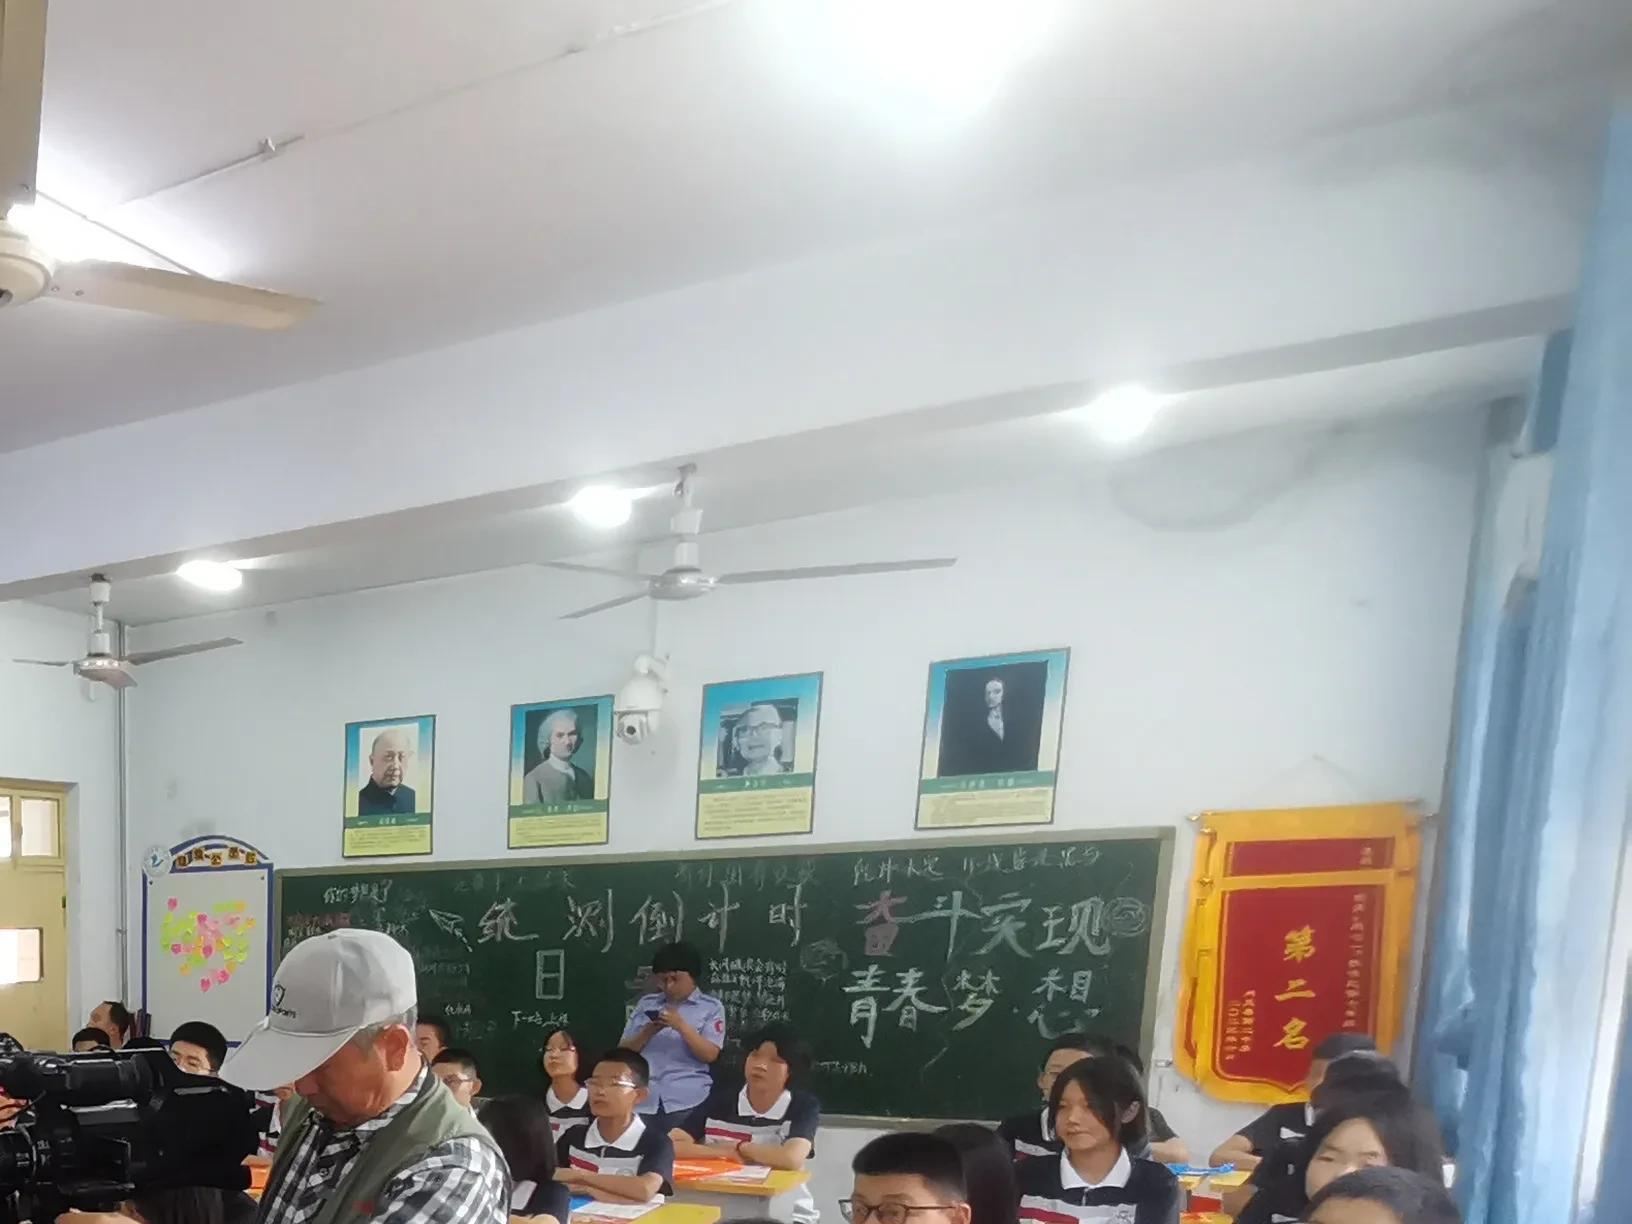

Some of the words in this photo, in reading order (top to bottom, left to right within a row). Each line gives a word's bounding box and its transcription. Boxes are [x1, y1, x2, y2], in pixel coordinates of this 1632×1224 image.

[840, 962, 1103, 1049] 青春梦想
[1273, 924, 1317, 1051] 第二名
